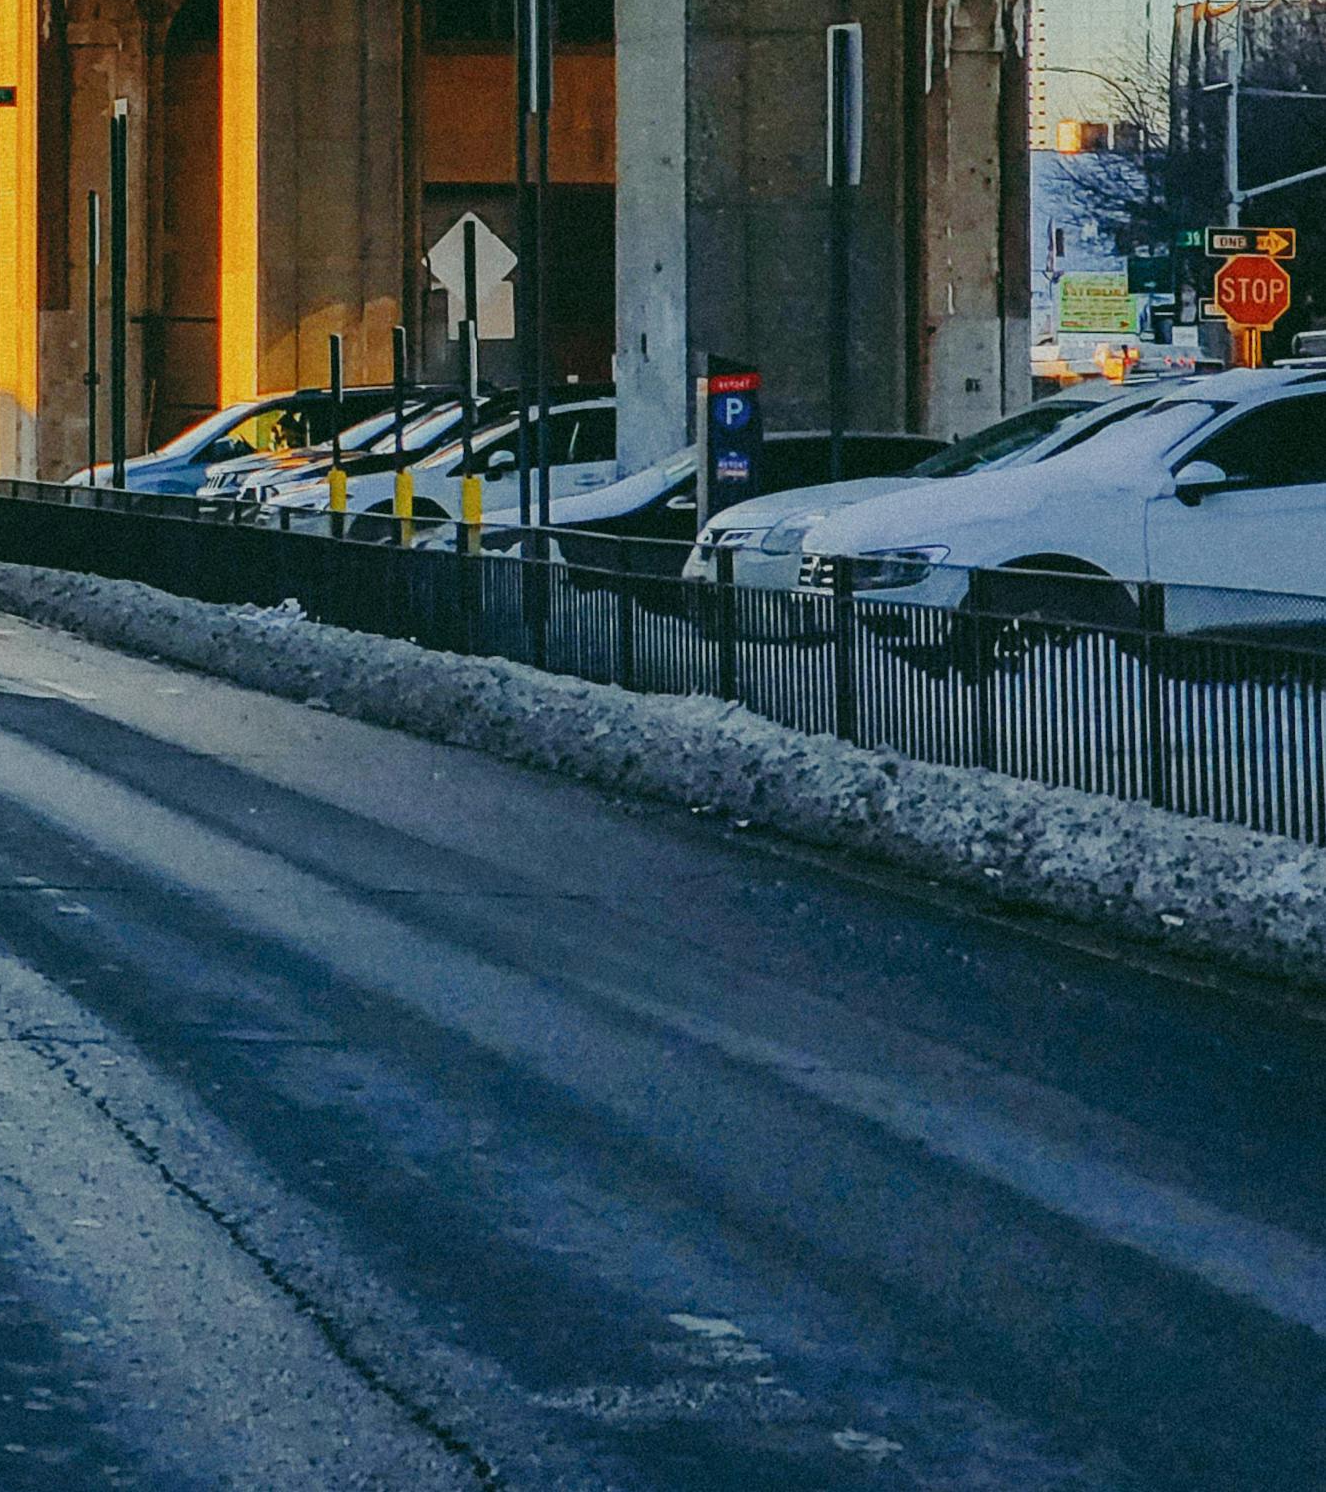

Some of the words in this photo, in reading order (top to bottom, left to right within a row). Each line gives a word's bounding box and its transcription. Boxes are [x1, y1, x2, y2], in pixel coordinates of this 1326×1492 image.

[1219, 237, 1247, 247] ONE
[1221, 277, 1286, 304] STOP
[726, 397, 744, 426] P
